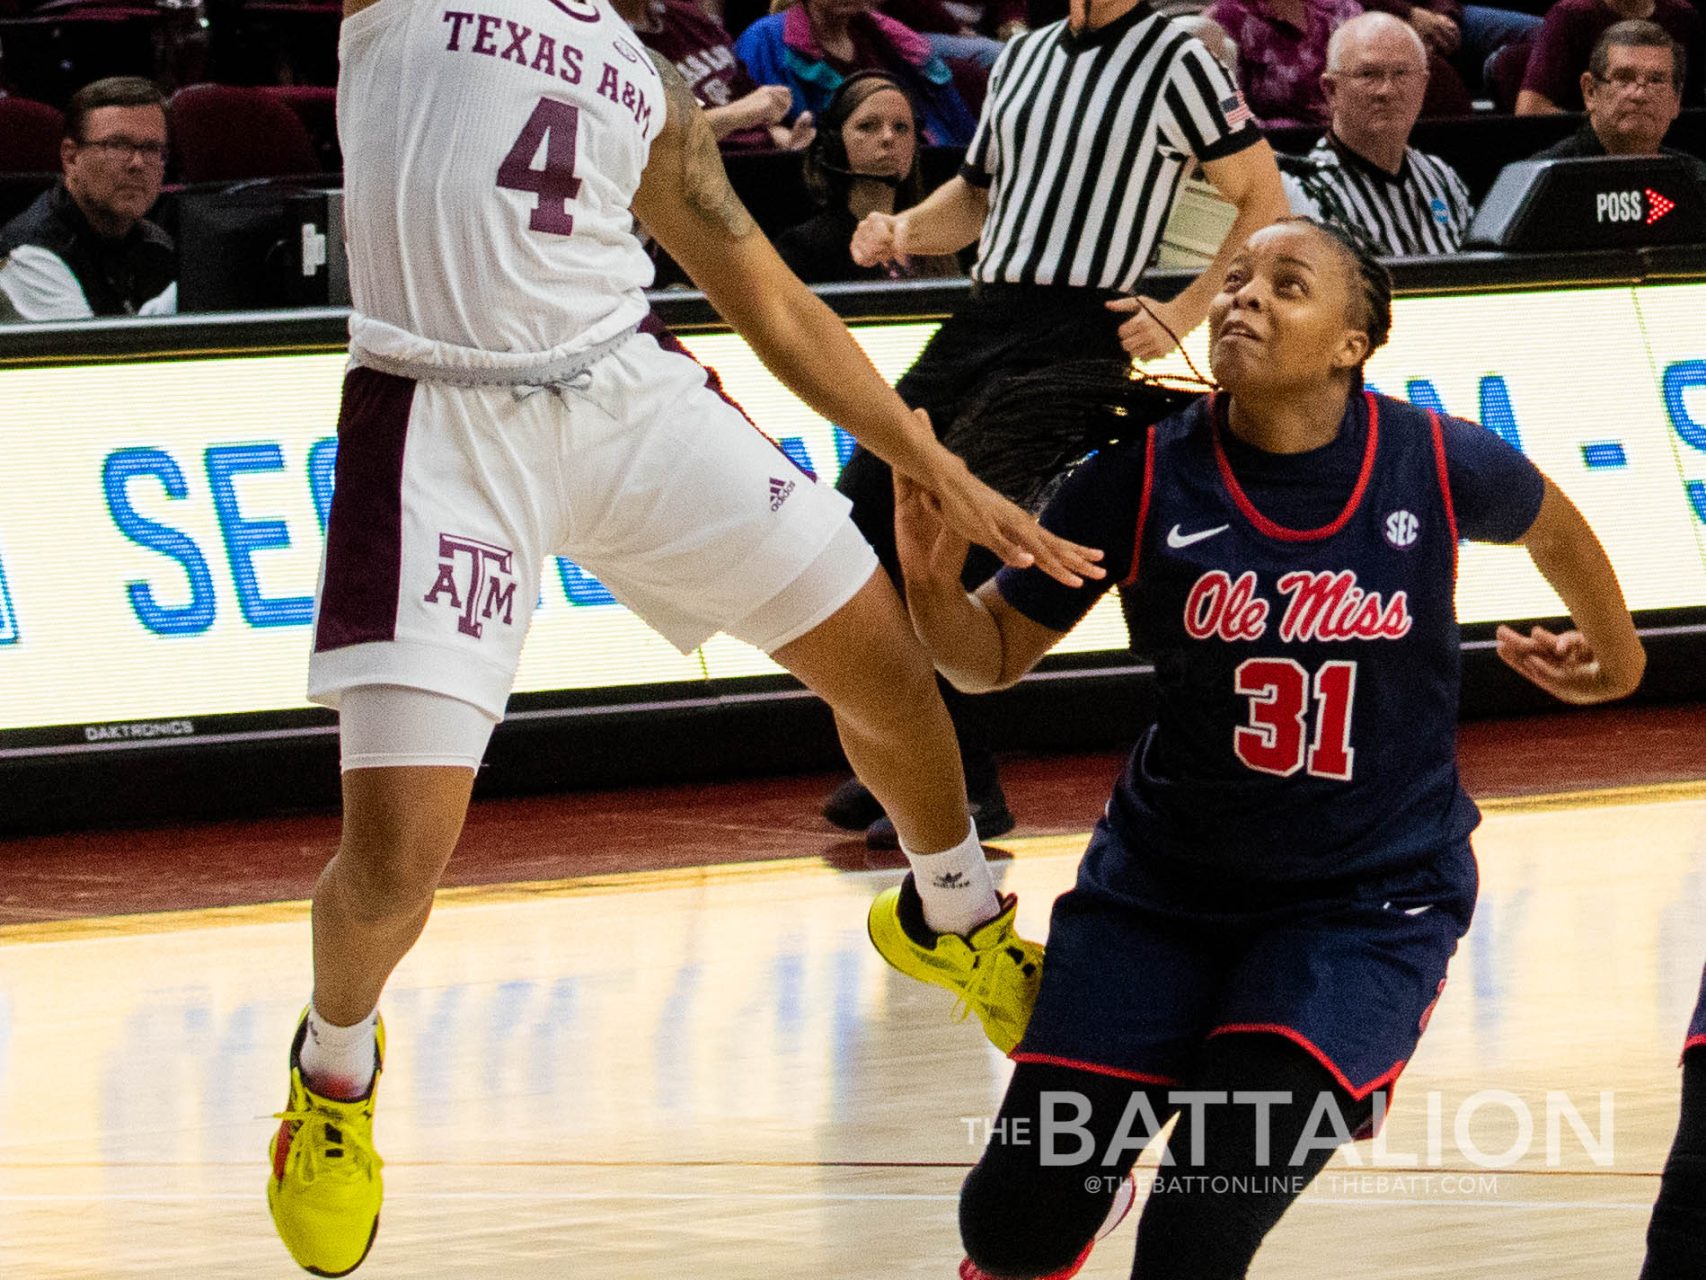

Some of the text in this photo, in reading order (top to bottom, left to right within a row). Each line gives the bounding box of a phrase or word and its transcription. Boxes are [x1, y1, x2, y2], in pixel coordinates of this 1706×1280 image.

[442, 10, 583, 86] TEXAS
[596, 62, 652, 140] A&M
[495, 95, 582, 237] 4
[1596, 190, 1642, 223] POSS
[770, 480, 796, 512] adidas
[1386, 509, 1419, 547] SEC
[1184, 568, 1413, 644] Ole Miss
[84, 720, 194, 741] DAKTRONICS
[1234, 656, 1358, 782] 31
